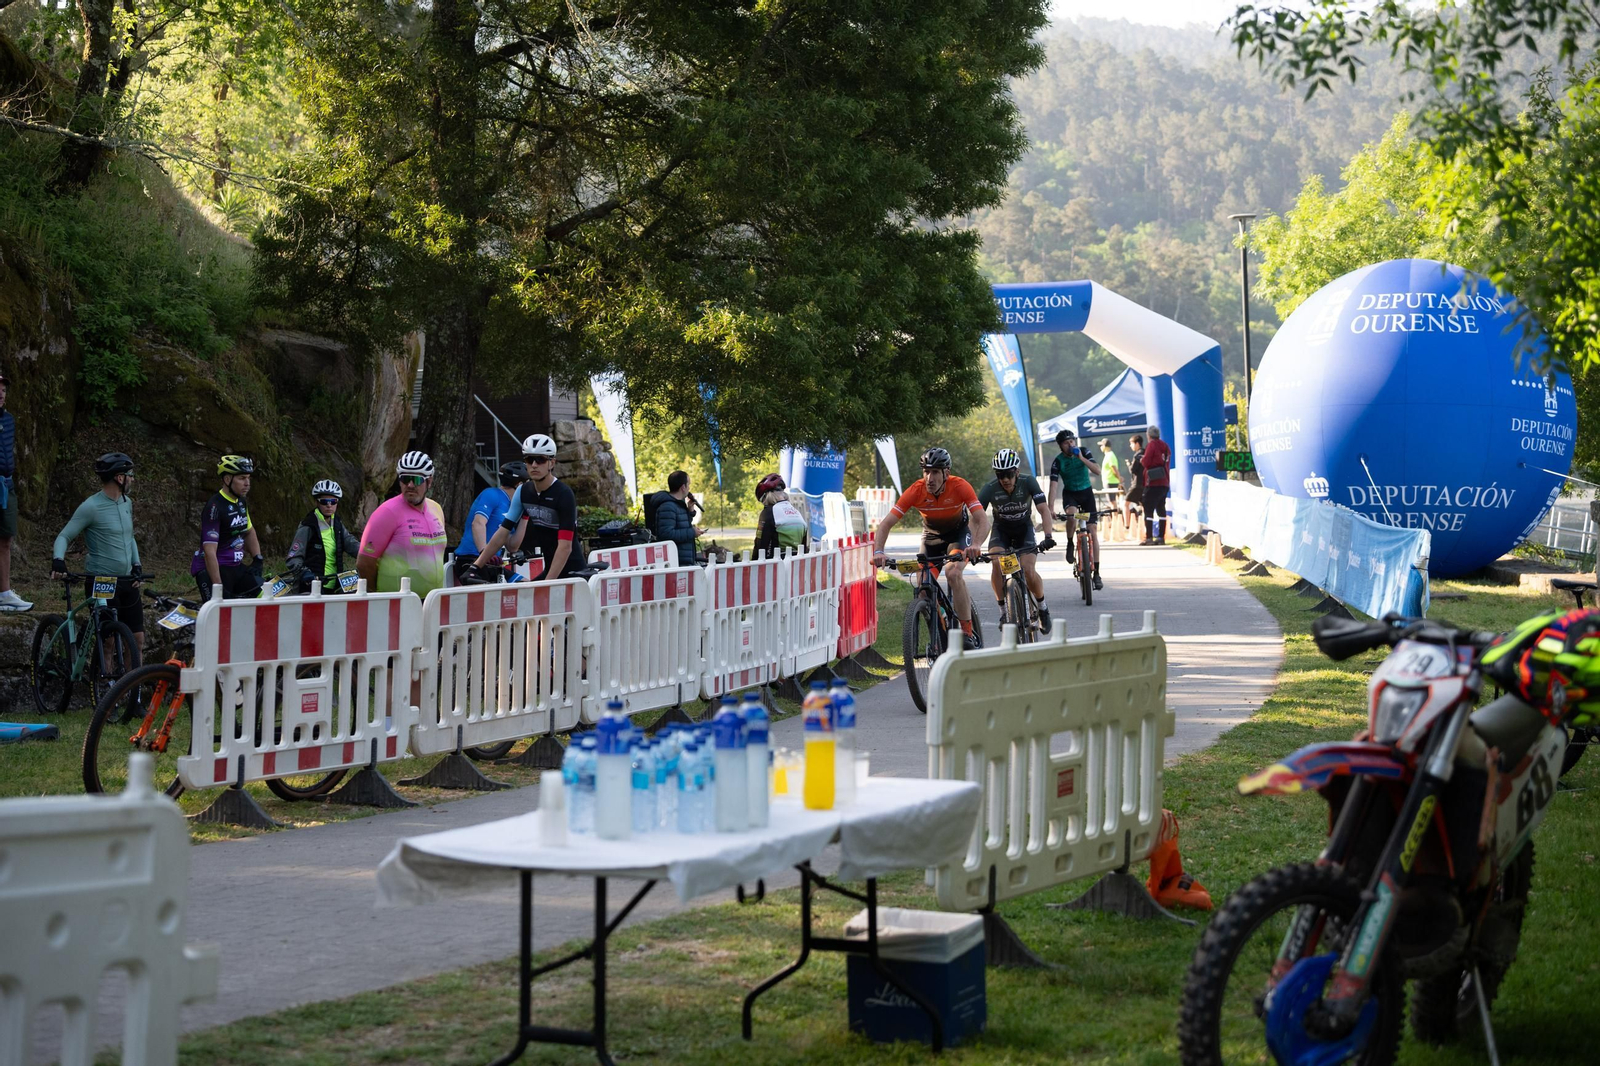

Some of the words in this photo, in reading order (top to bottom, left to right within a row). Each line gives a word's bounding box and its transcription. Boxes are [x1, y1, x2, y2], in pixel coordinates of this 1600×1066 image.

[993, 293, 1073, 309] PUTACIÓN
[1356, 292, 1507, 315] DEPUTACIÓN
[1350, 313, 1480, 334] OURENSE
[1511, 417, 1573, 440] DEPUTACIÓN
[1521, 436, 1566, 456] OURENSE
[804, 460, 840, 469] OURENSE
[1189, 454, 1217, 464] OUREN
[1347, 482, 1516, 509] DEPUTACIÓN
